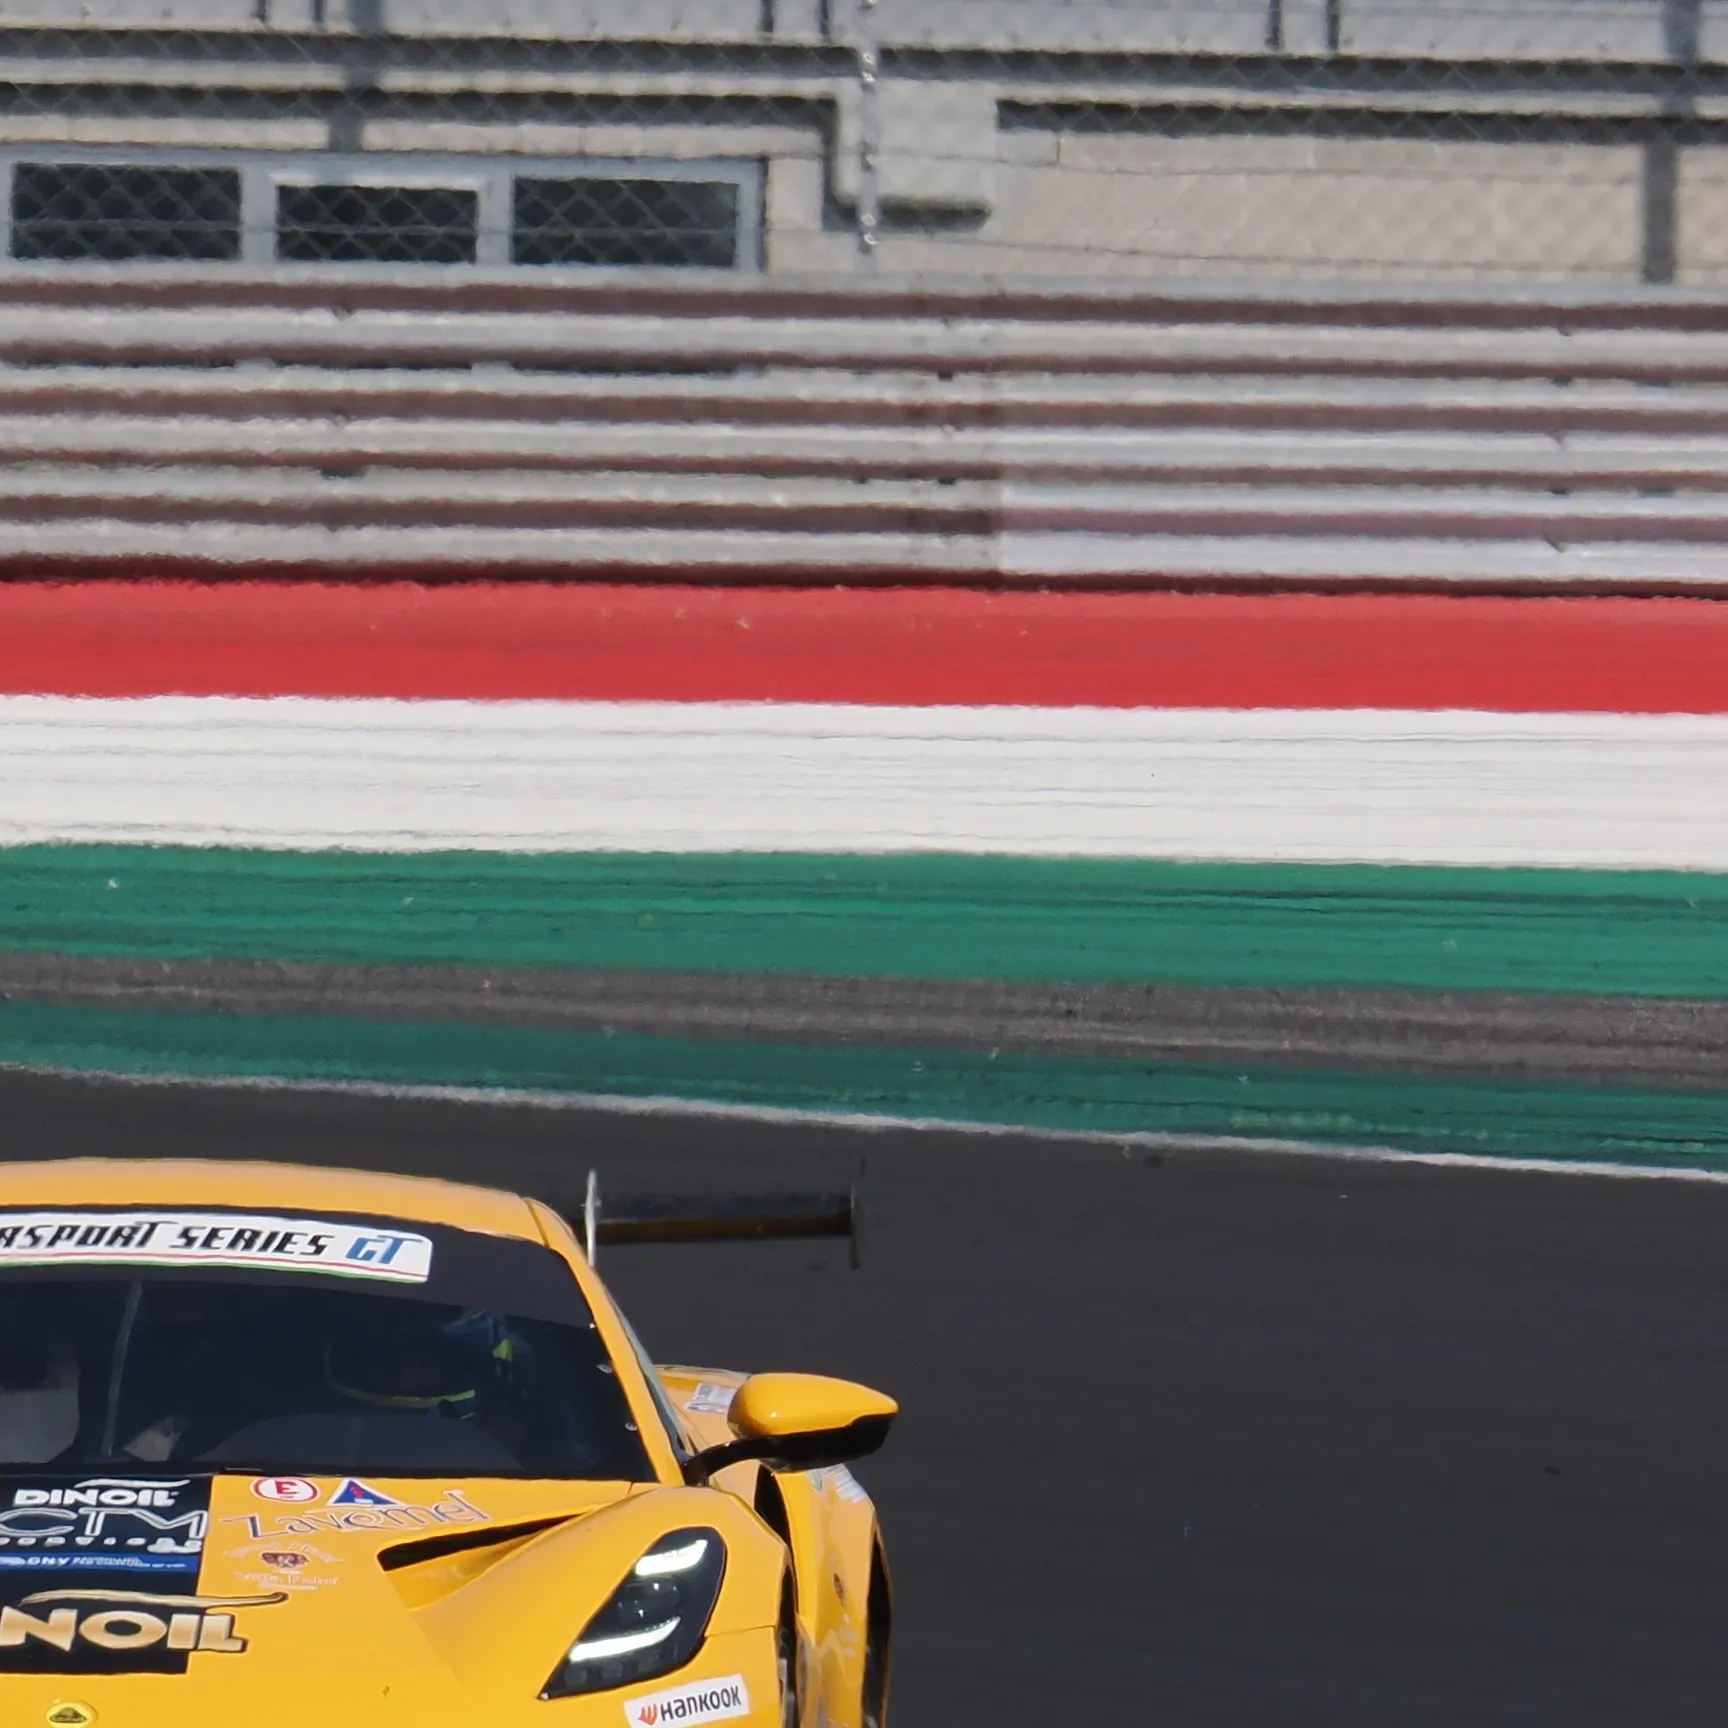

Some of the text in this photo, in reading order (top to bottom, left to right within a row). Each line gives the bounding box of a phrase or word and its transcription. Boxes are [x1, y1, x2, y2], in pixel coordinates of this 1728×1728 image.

[169, 1226, 335, 1256] SERIES
[345, 1235, 423, 1265] GT
[13, 1488, 177, 1507] DINOIL
[275, 1481, 299, 1495] E
